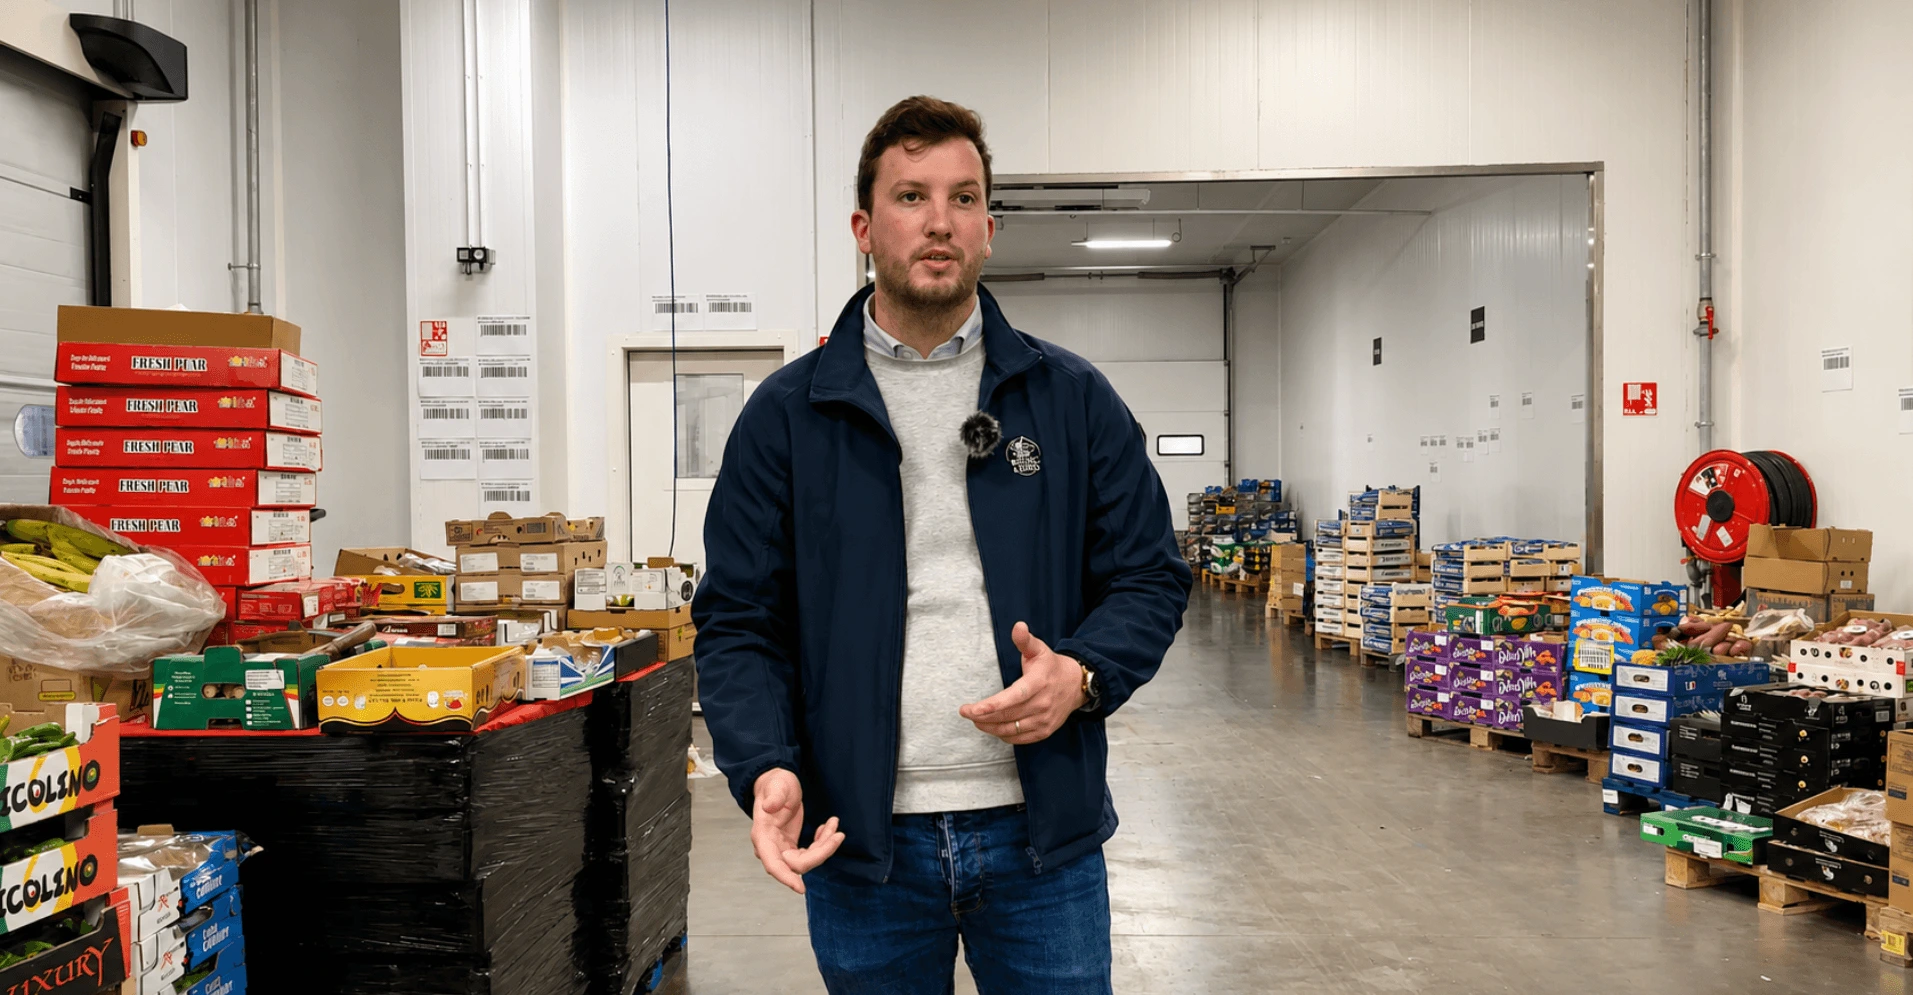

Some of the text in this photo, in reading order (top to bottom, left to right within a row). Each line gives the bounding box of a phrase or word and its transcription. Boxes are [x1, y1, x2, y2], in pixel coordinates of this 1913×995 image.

[131, 356, 172, 370] FRESH
[126, 398, 198, 413] FRESH PEAR
[123, 439, 194, 454] FRESH PEAR
[118, 479, 189, 493] FRESH PEAR
[110, 518, 181, 532] FRESH PEAR
